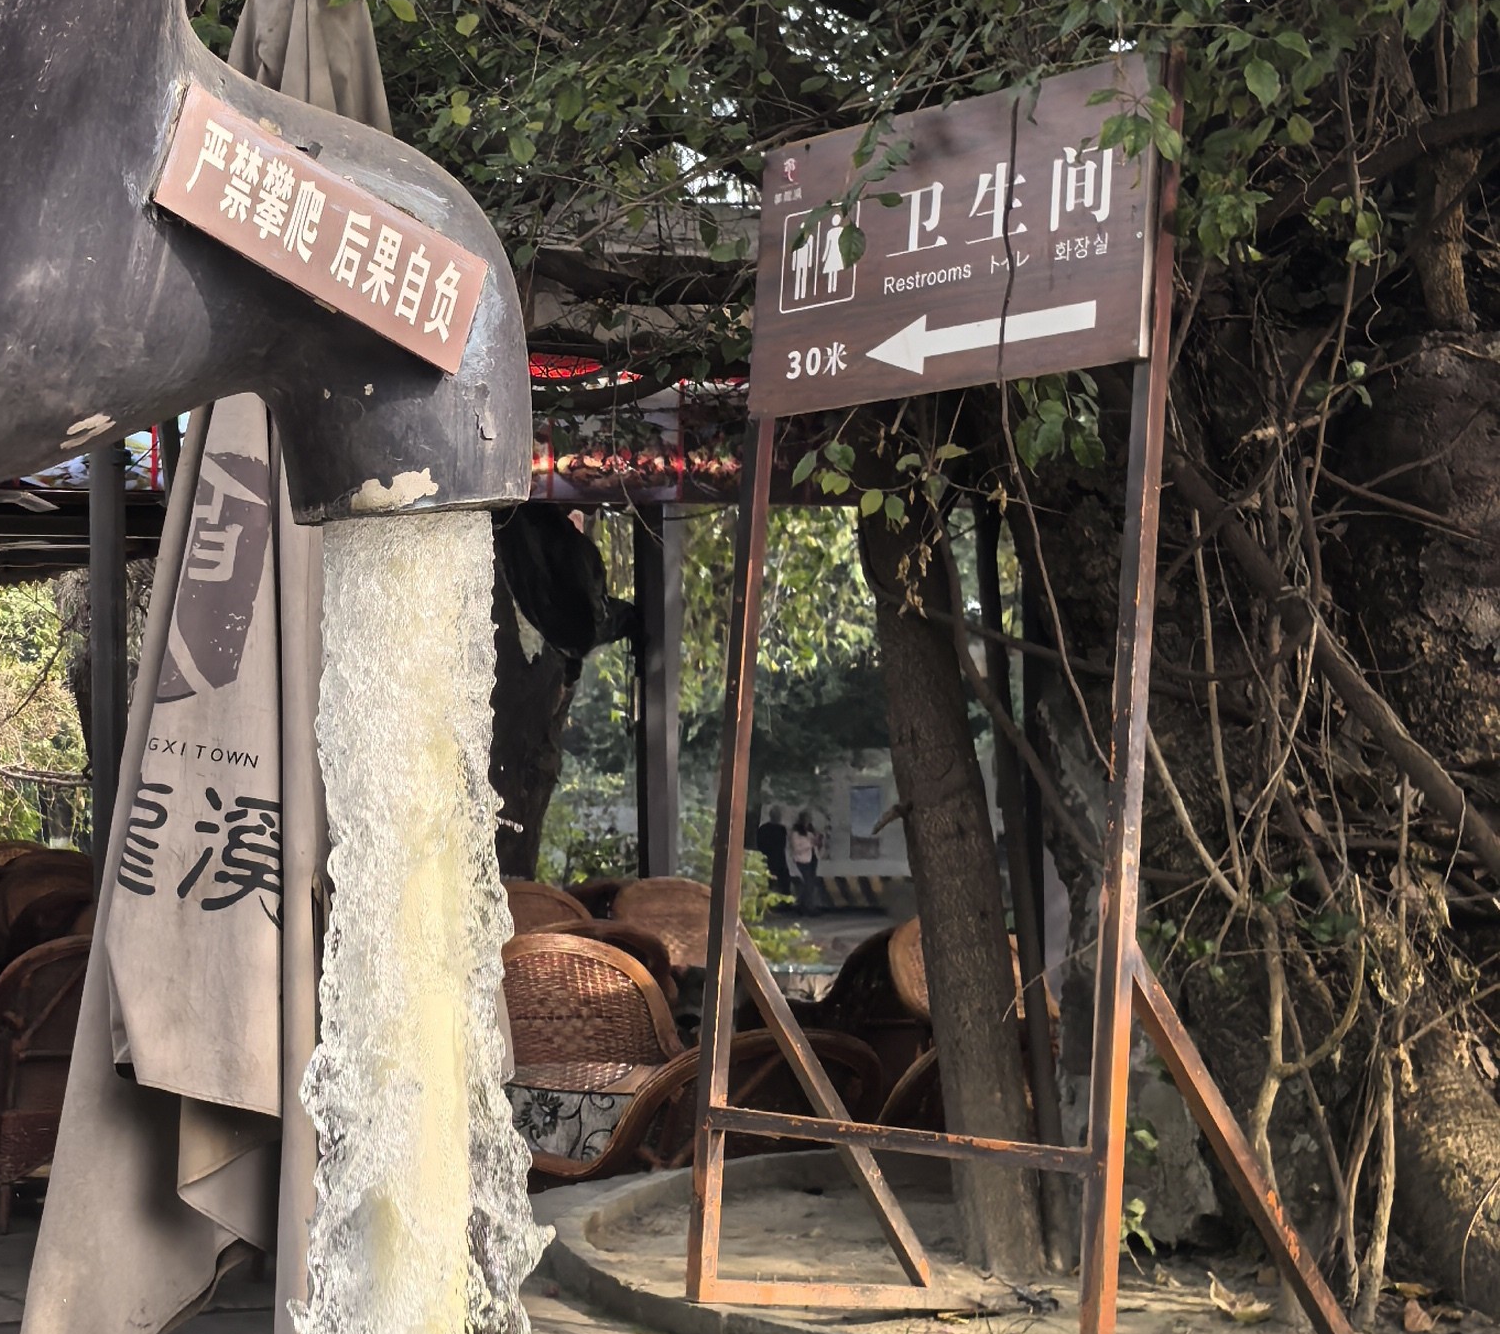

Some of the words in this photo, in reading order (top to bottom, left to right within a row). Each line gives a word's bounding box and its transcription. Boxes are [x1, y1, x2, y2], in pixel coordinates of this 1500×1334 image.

[885, 146, 1114, 258] 卫生间
[185, 118, 326, 264] 严禁攀爬
[330, 209, 463, 344] 后果自负
[1053, 231, 1110, 262] 화장실
[883, 263, 972, 296] Restrooms
[785, 341, 849, 380] 30米
[195, 744, 260, 769] TOWN
